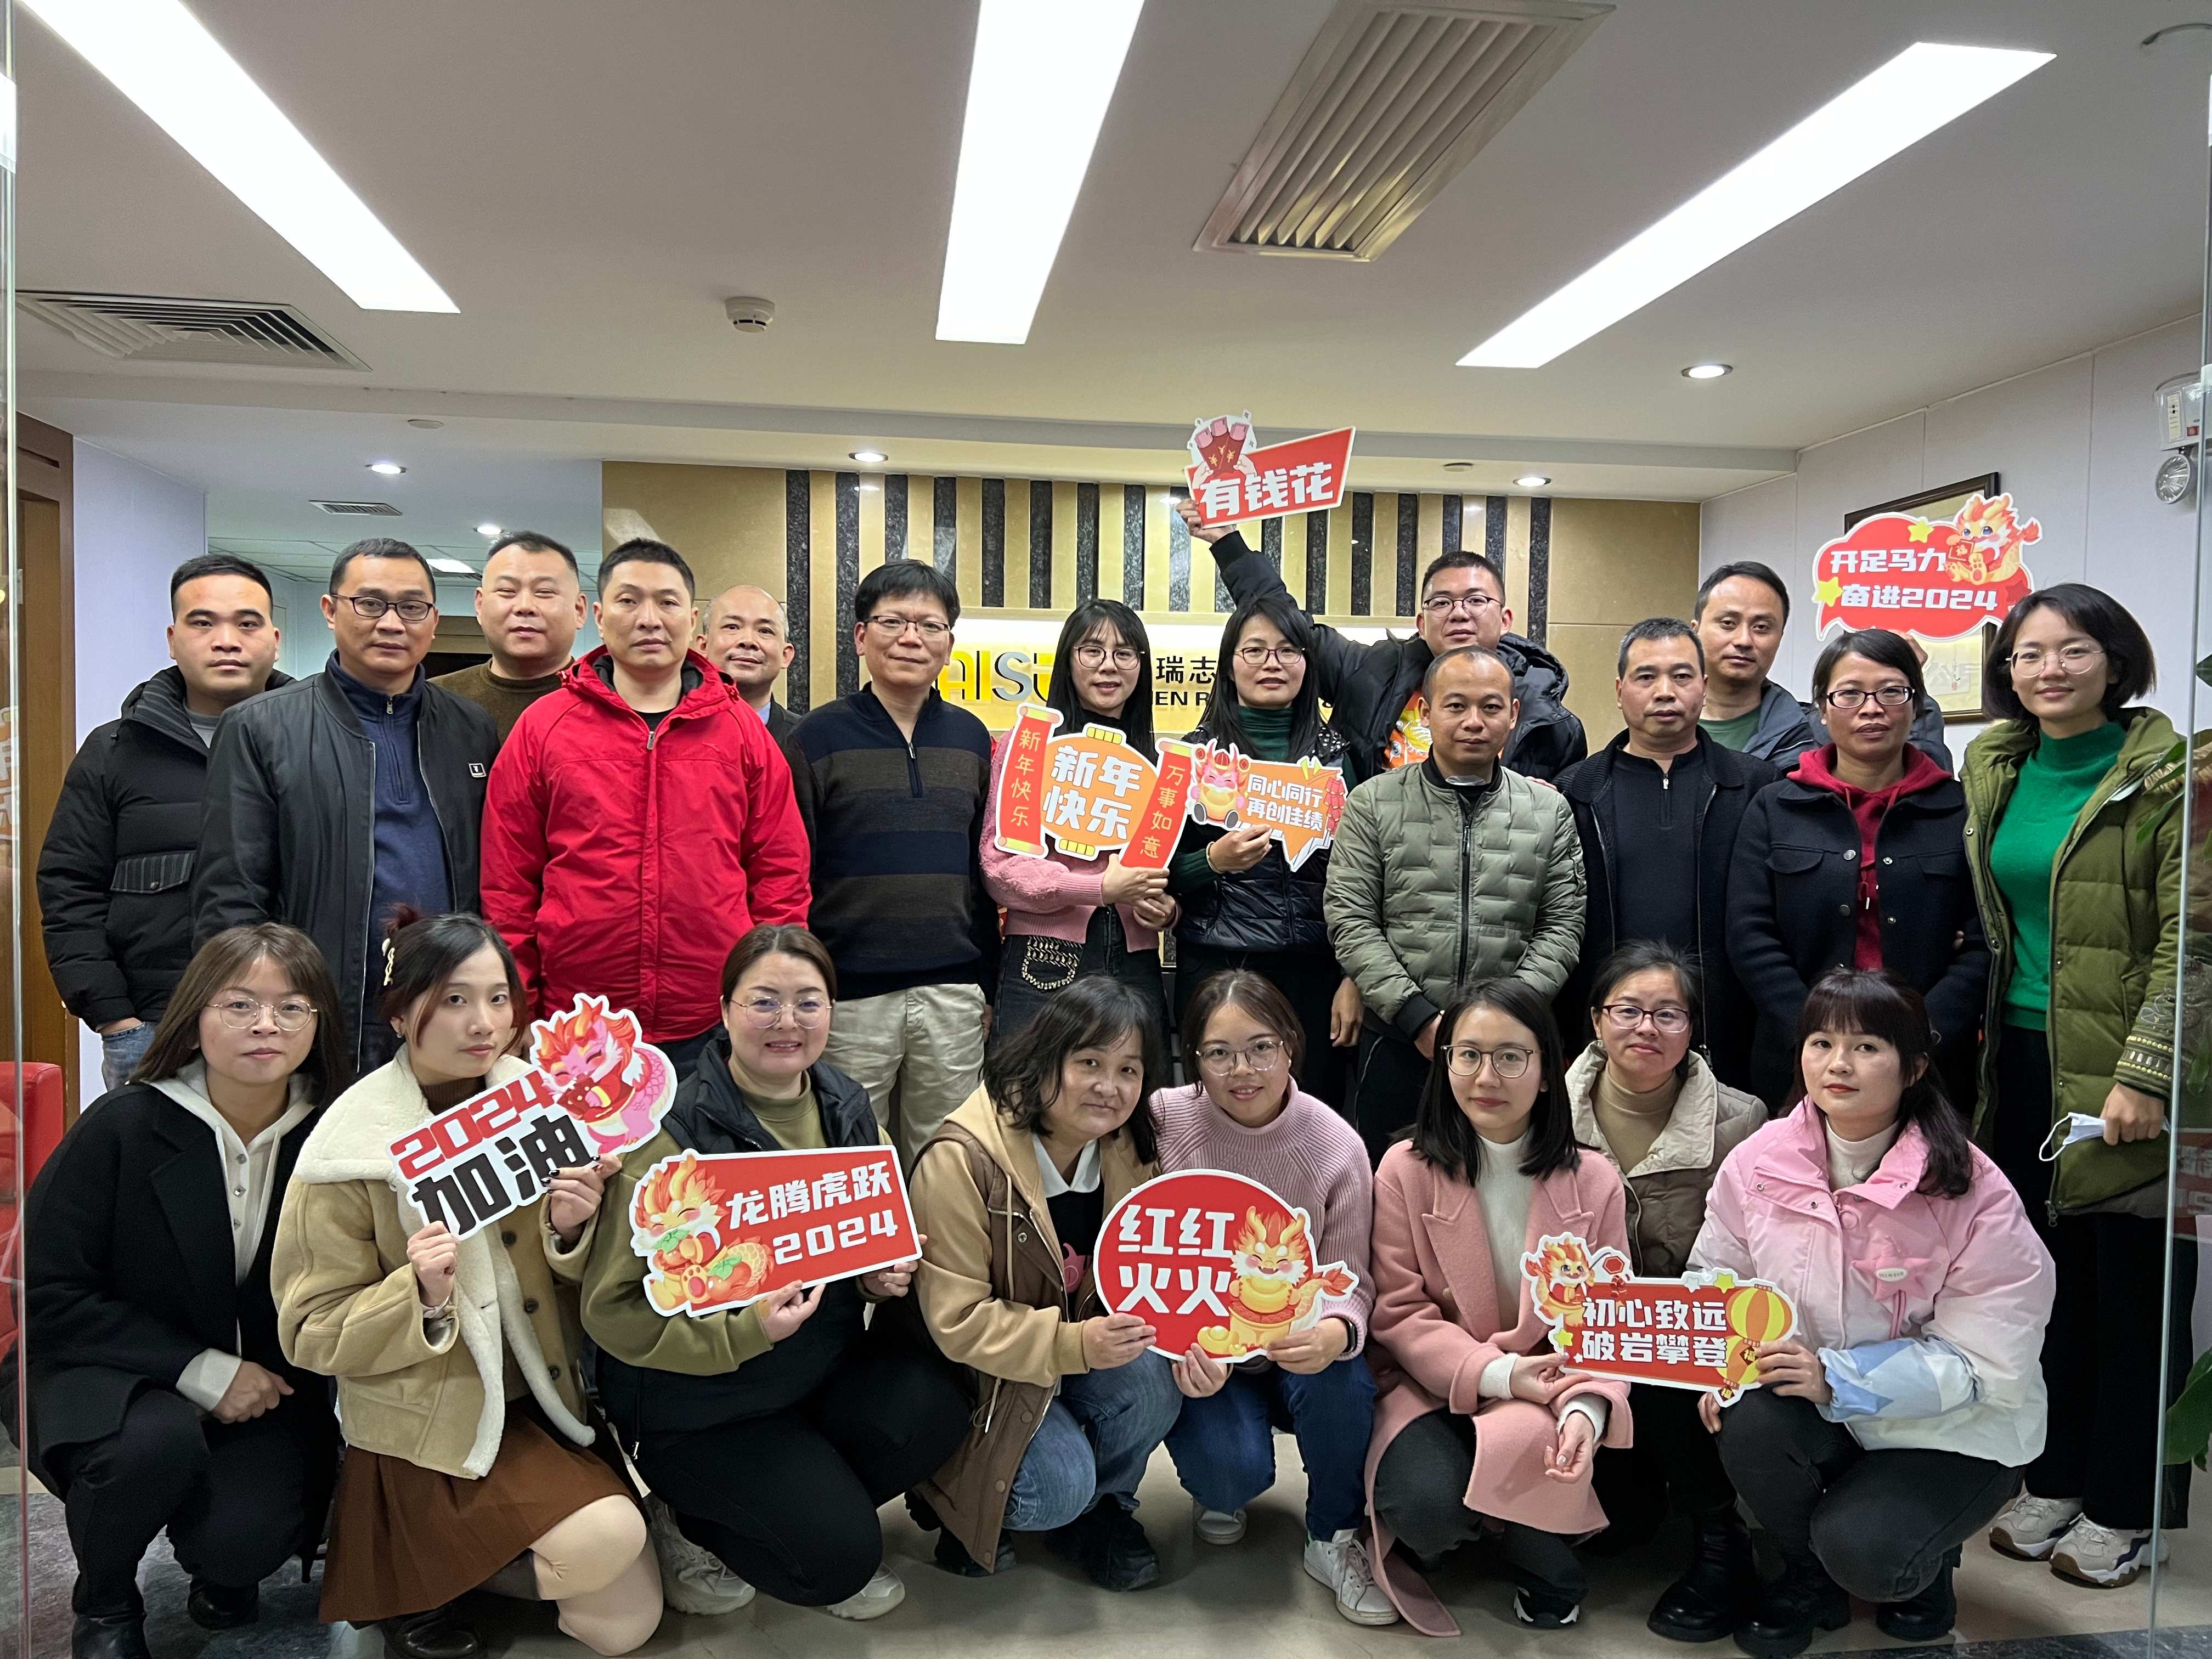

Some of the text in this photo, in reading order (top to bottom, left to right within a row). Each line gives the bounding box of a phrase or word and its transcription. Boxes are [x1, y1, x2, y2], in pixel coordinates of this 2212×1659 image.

[1200, 462, 1334, 519] 有钱花
[1830, 548, 1948, 574] 开足马力
[1841, 584, 1998, 611] 奋进2024
[1155, 656, 1216, 684] 瑞志
[1152, 691, 1188, 706] EN
[1011, 727, 1041, 827] 新年快乐
[1050, 745, 1143, 797] 新年
[1247, 774, 1324, 808] 同心同行
[1042, 786, 1132, 839] 快乐
[1141, 765, 1185, 859] 万事如意
[1247, 797, 1323, 831] 再创佳绩
[390, 1070, 554, 1180] 2024
[412, 1114, 591, 1235] 加油
[725, 1161, 893, 1229] 龙腾虎跃
[772, 1209, 899, 1265] 2024
[1118, 1204, 1235, 1258] 红红
[1116, 1262, 1231, 1317] 火火
[1582, 1297, 1727, 1331] 初心致远
[1581, 1330, 1728, 1368] 破岩攀登
